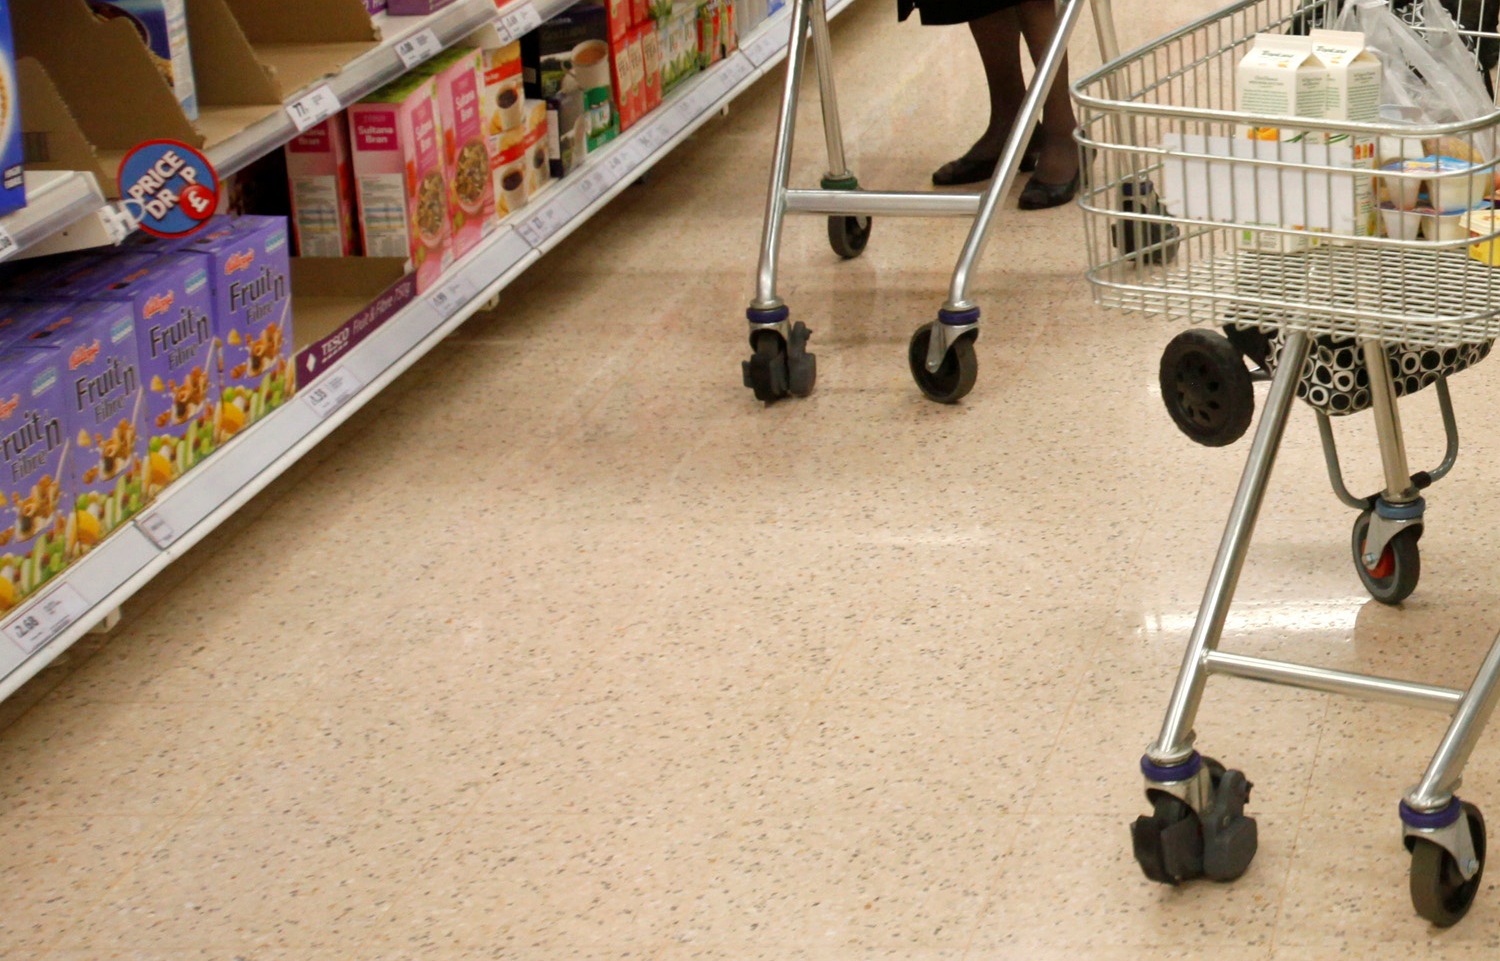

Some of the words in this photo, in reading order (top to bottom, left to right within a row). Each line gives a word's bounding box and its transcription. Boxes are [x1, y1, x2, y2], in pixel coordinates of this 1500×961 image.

[358, 125, 394, 135] Sultana
[127, 150, 187, 204] PRICE
[187, 190, 210, 214] £
[246, 303, 274, 326] Fibre
[321, 326, 349, 357] TESCO
[168, 344, 197, 372] Fibre
[94, 398, 128, 424] Fibre
[11, 452, 46, 482] Fibre
